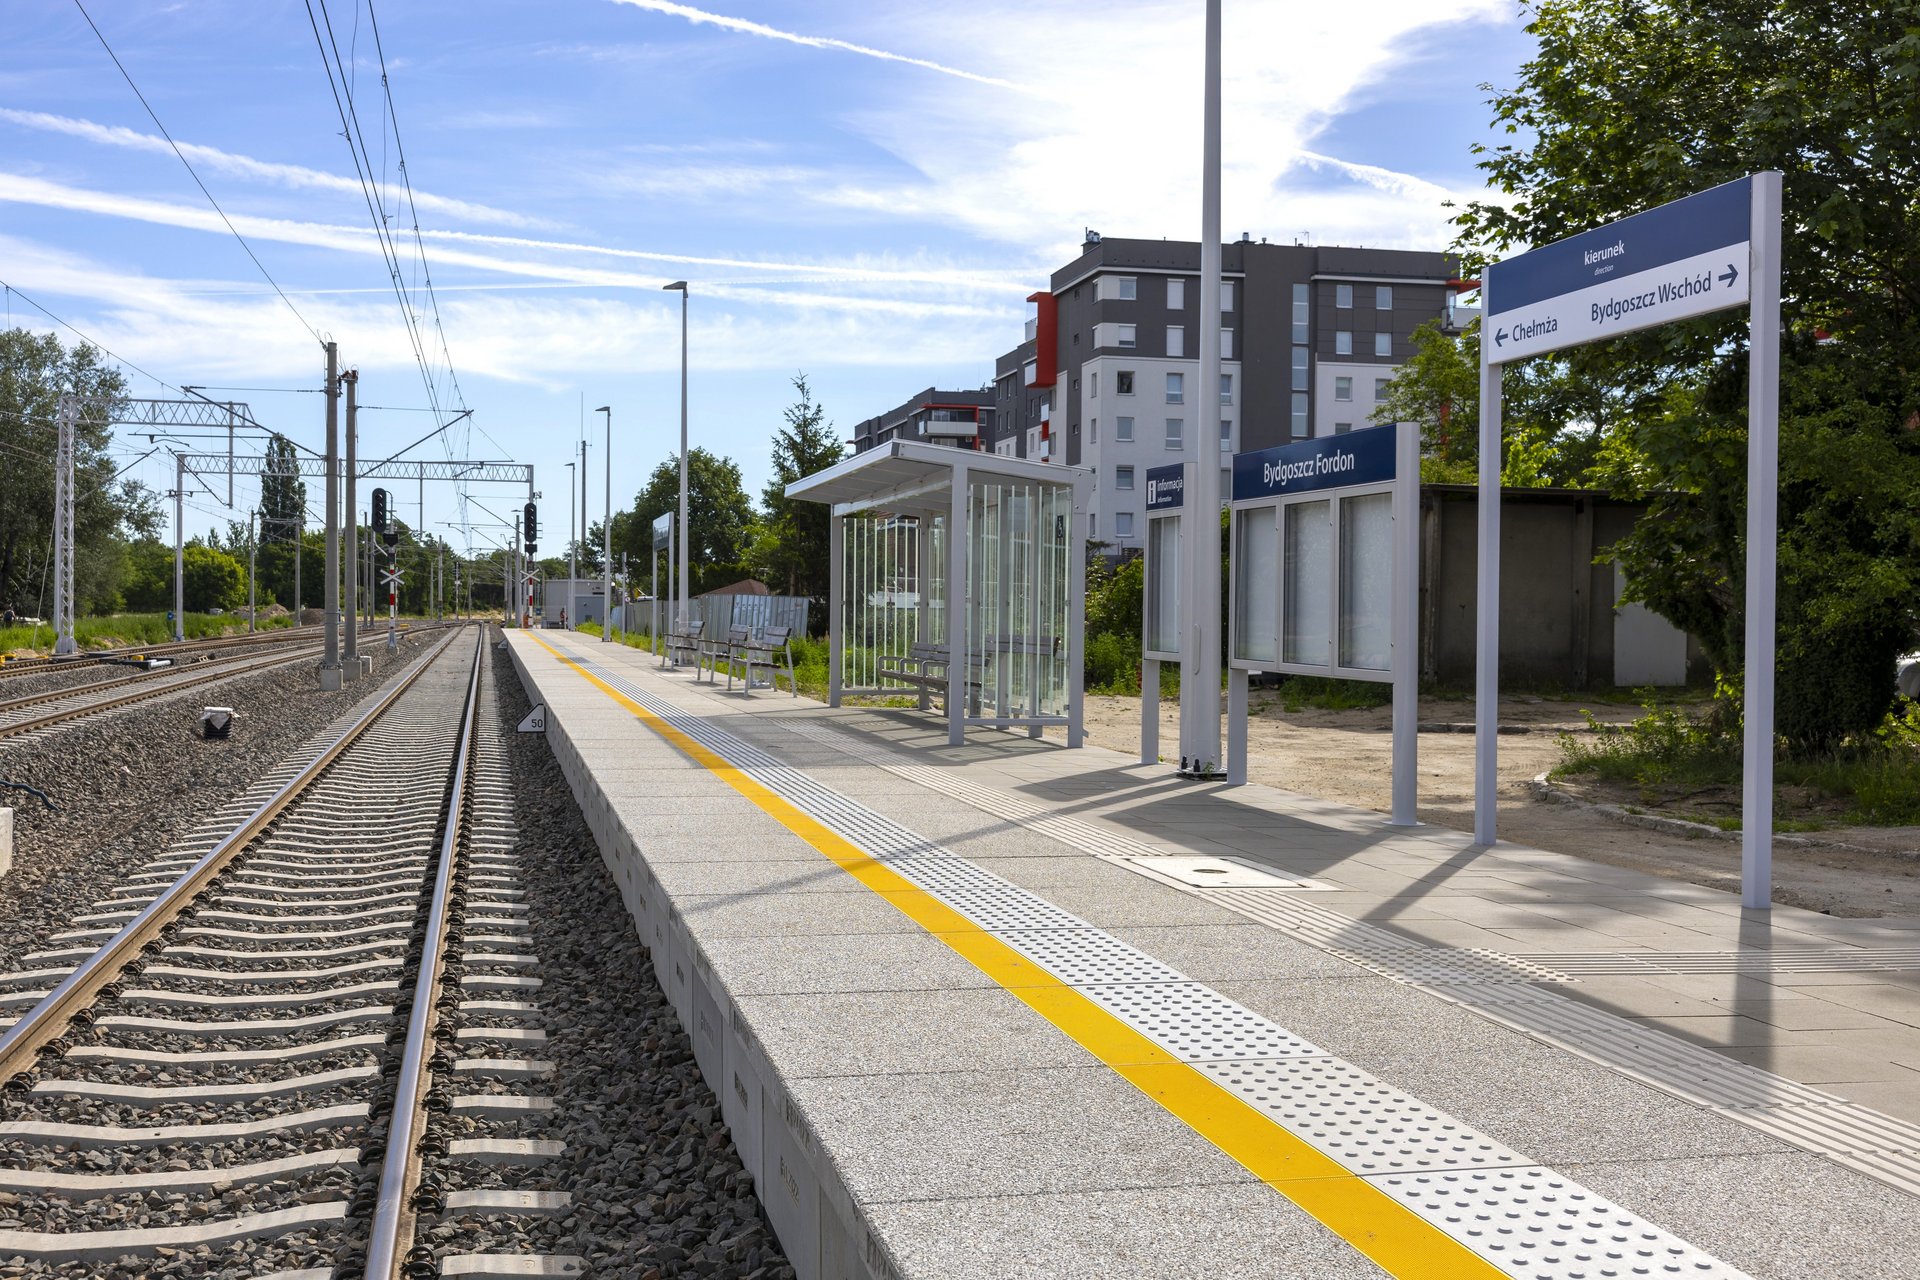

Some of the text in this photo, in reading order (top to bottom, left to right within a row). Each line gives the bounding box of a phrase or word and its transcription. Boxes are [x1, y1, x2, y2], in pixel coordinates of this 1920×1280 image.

[1584, 240, 1625, 265] kierunek
[1594, 264, 1614, 276] direction
[1591, 271, 1711, 324] Bydgoszcz Wschód
[1512, 316, 1558, 342] Chełmża
[1263, 449, 1355, 487] Bydgoszcz Fordon
[1157, 476, 1183, 491] informacja
[531, 718, 543, 728] 50
